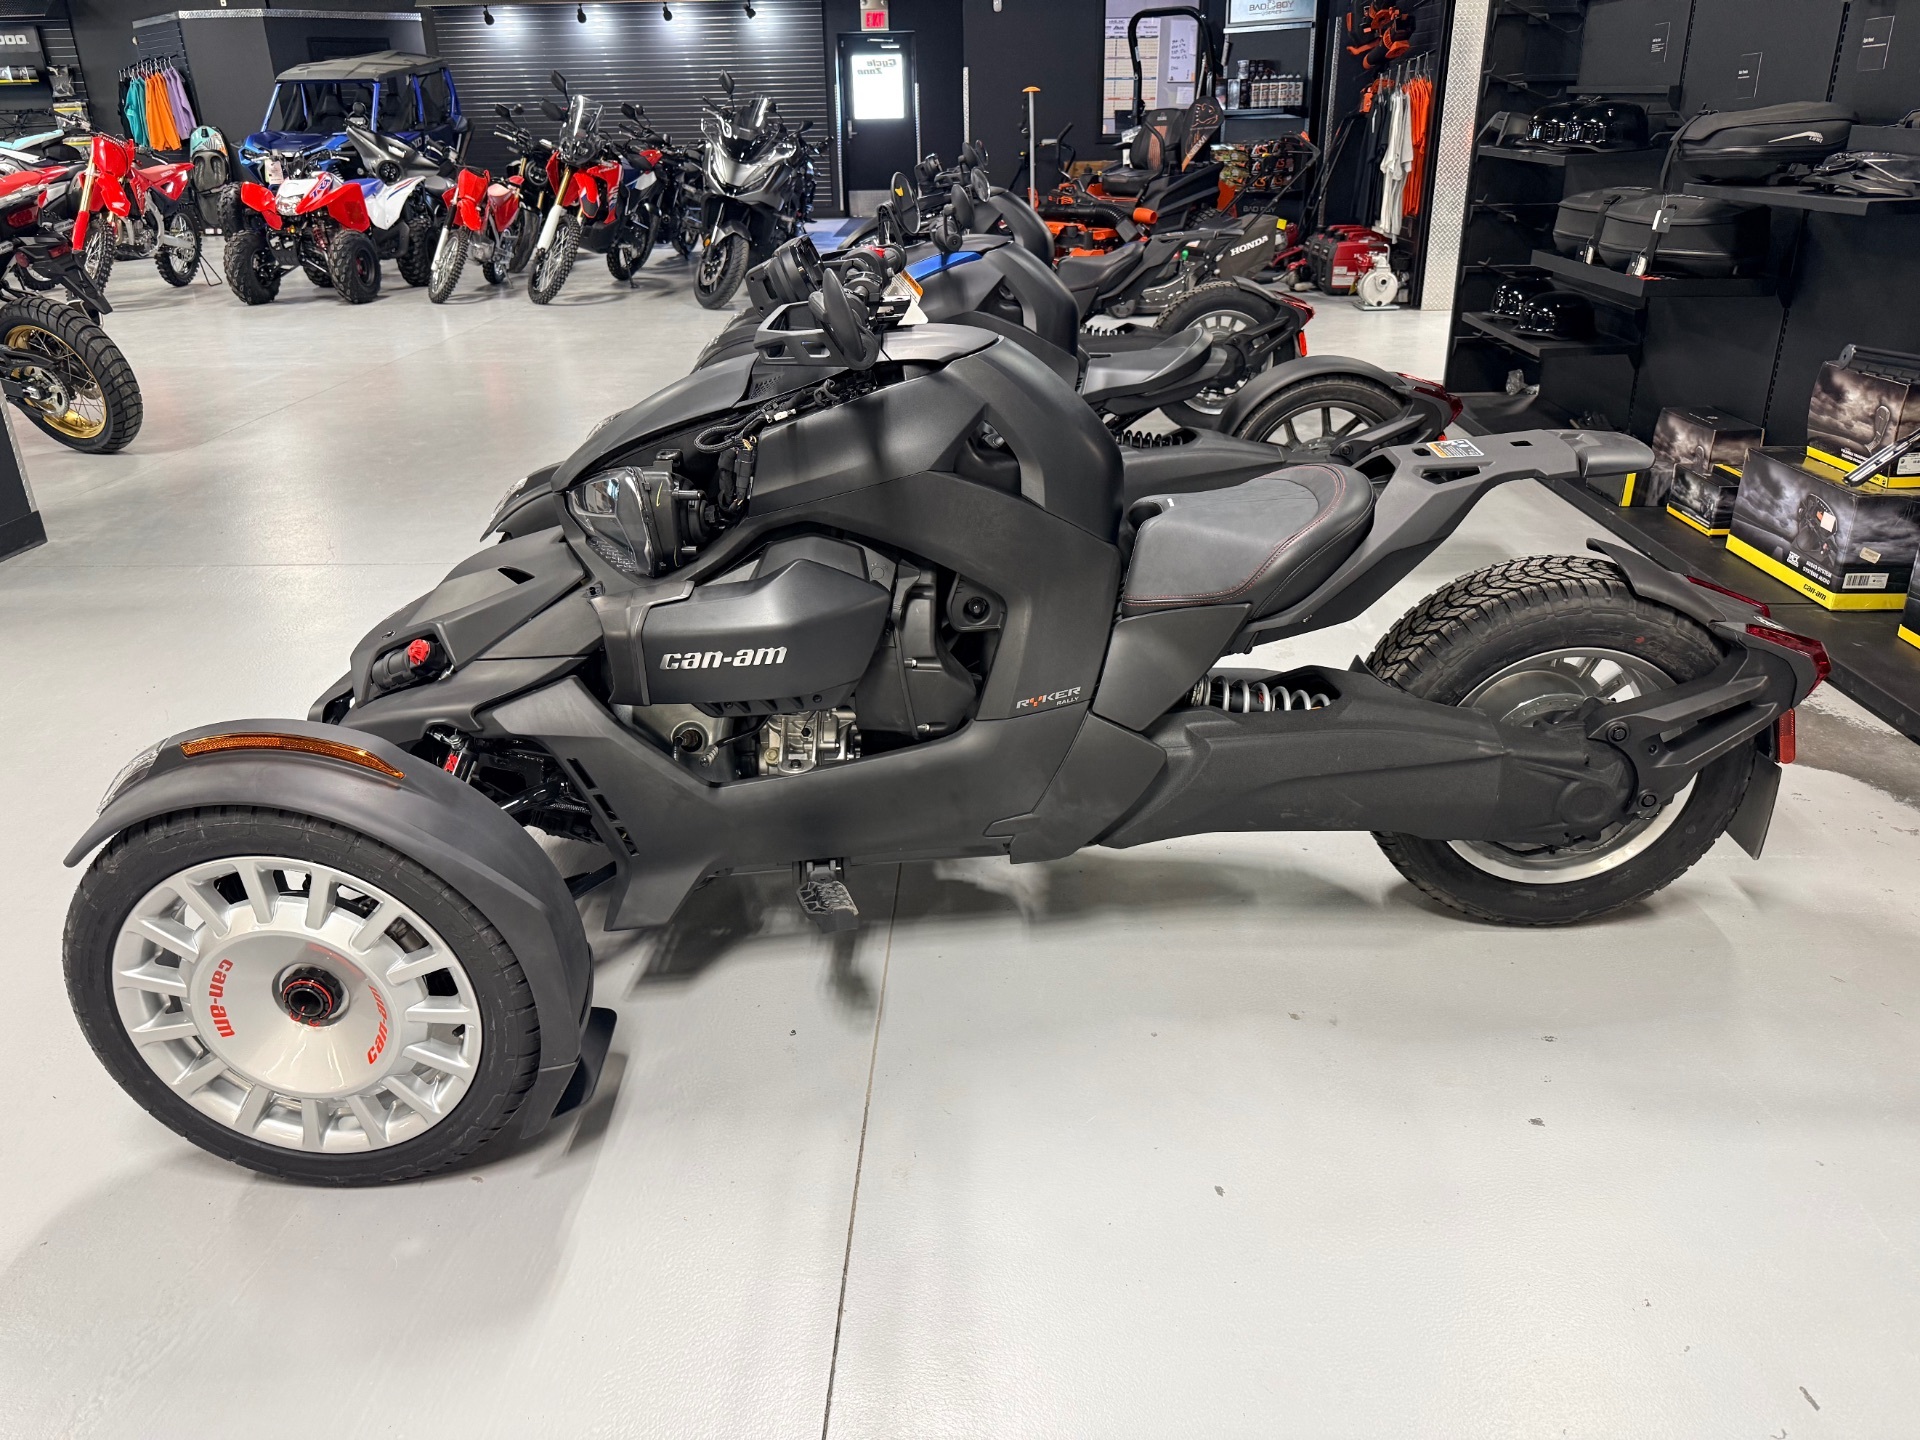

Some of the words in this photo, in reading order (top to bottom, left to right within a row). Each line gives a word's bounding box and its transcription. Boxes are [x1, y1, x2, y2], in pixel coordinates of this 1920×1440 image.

[1249, 3, 1267, 12] BAD
[1276, 1, 1295, 9] BOY
[865, 11, 885, 28] EXIT
[1229, 234, 1269, 257] HONDA
[1803, 583, 1827, 601] can-am
[660, 646, 787, 670] can-am
[1016, 686, 1081, 709] RYKER
[1056, 696, 1079, 706] RALLY
[209, 958, 235, 1038] can-am
[367, 984, 388, 1065] can-am
